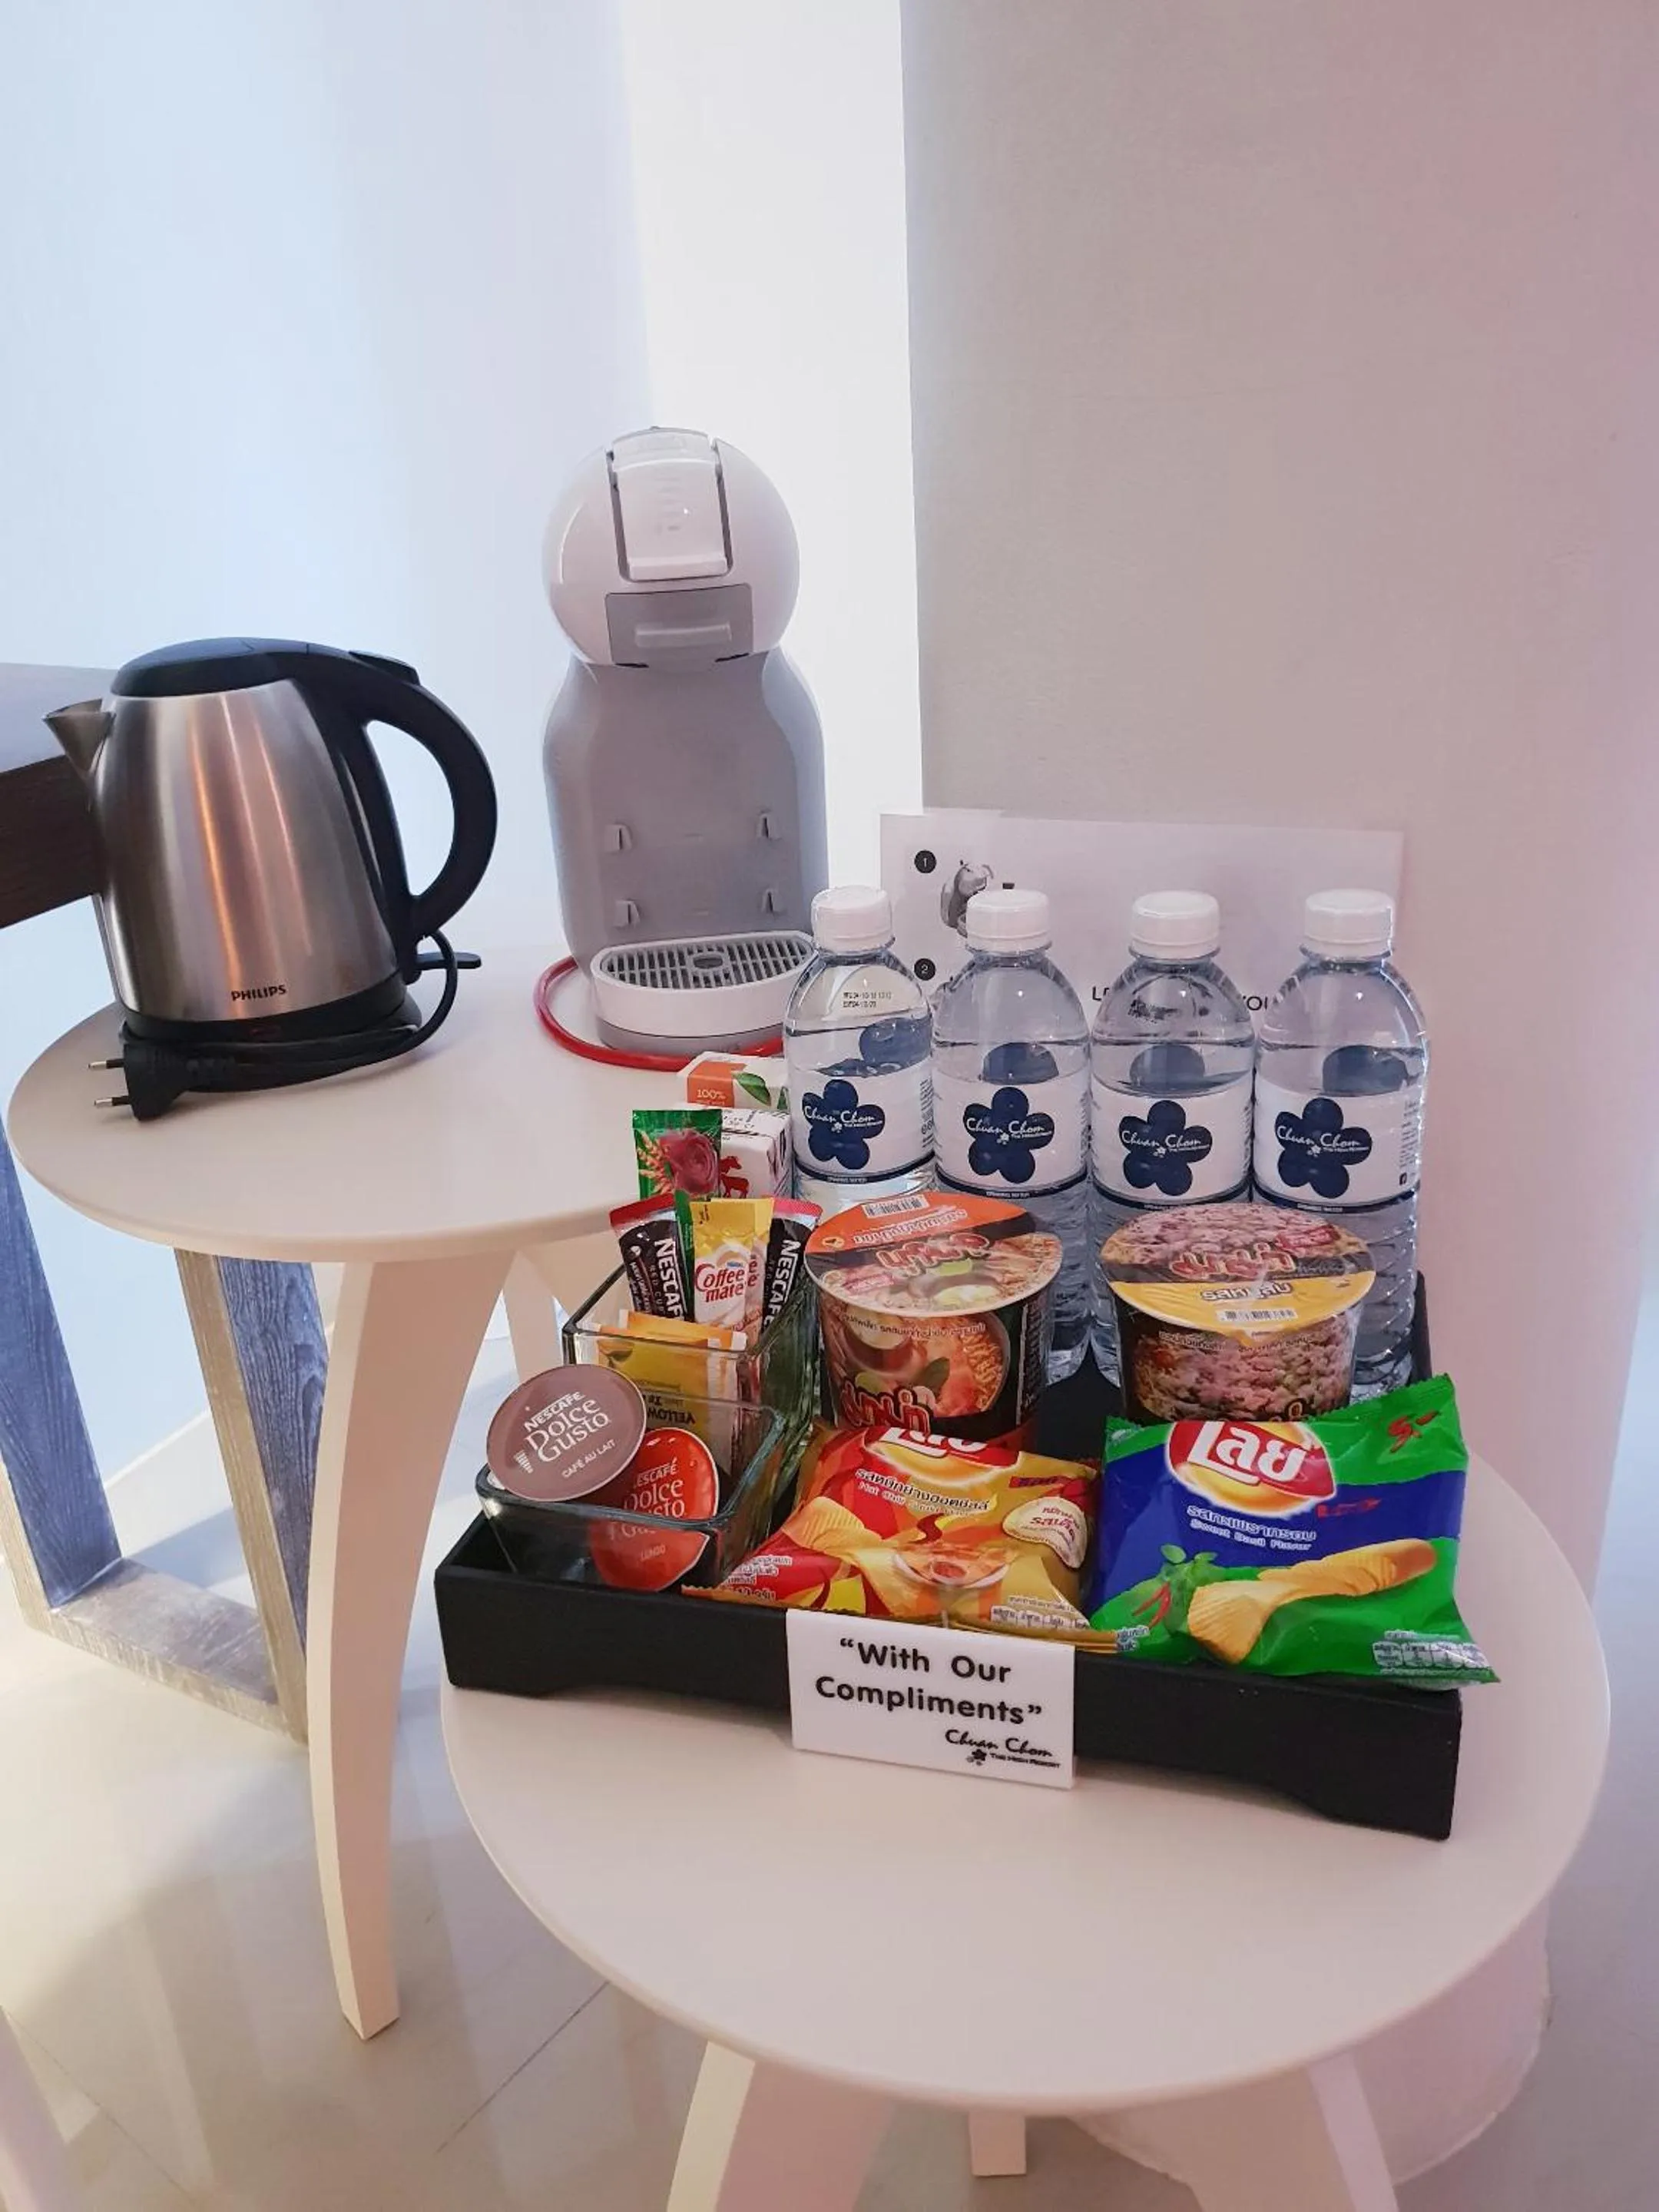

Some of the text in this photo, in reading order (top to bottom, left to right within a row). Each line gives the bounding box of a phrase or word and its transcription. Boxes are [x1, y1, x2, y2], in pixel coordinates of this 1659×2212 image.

[230, 984, 286, 1001] PHILIPS
[696, 1088, 727, 1100] 100%
[804, 1104, 876, 1124] Chuan Chom
[965, 1117, 1045, 1134] Chuan Chom
[1121, 1130, 1161, 1147] Chuan
[1164, 1134, 1201, 1149] Chom
[1277, 1125, 1361, 1148] Chuan Chom
[695, 1263, 746, 1293] Coffee
[705, 1283, 745, 1303] mate
[523, 1399, 601, 1451] Dolce
[538, 1412, 612, 1462] Gusto
[634, 1455, 678, 1489] ESCAFÉ
[839, 1637, 1012, 1683] “With Our
[815, 1675, 1042, 1725] Compliments”
[945, 1729, 1053, 1757] Chuan Chom
